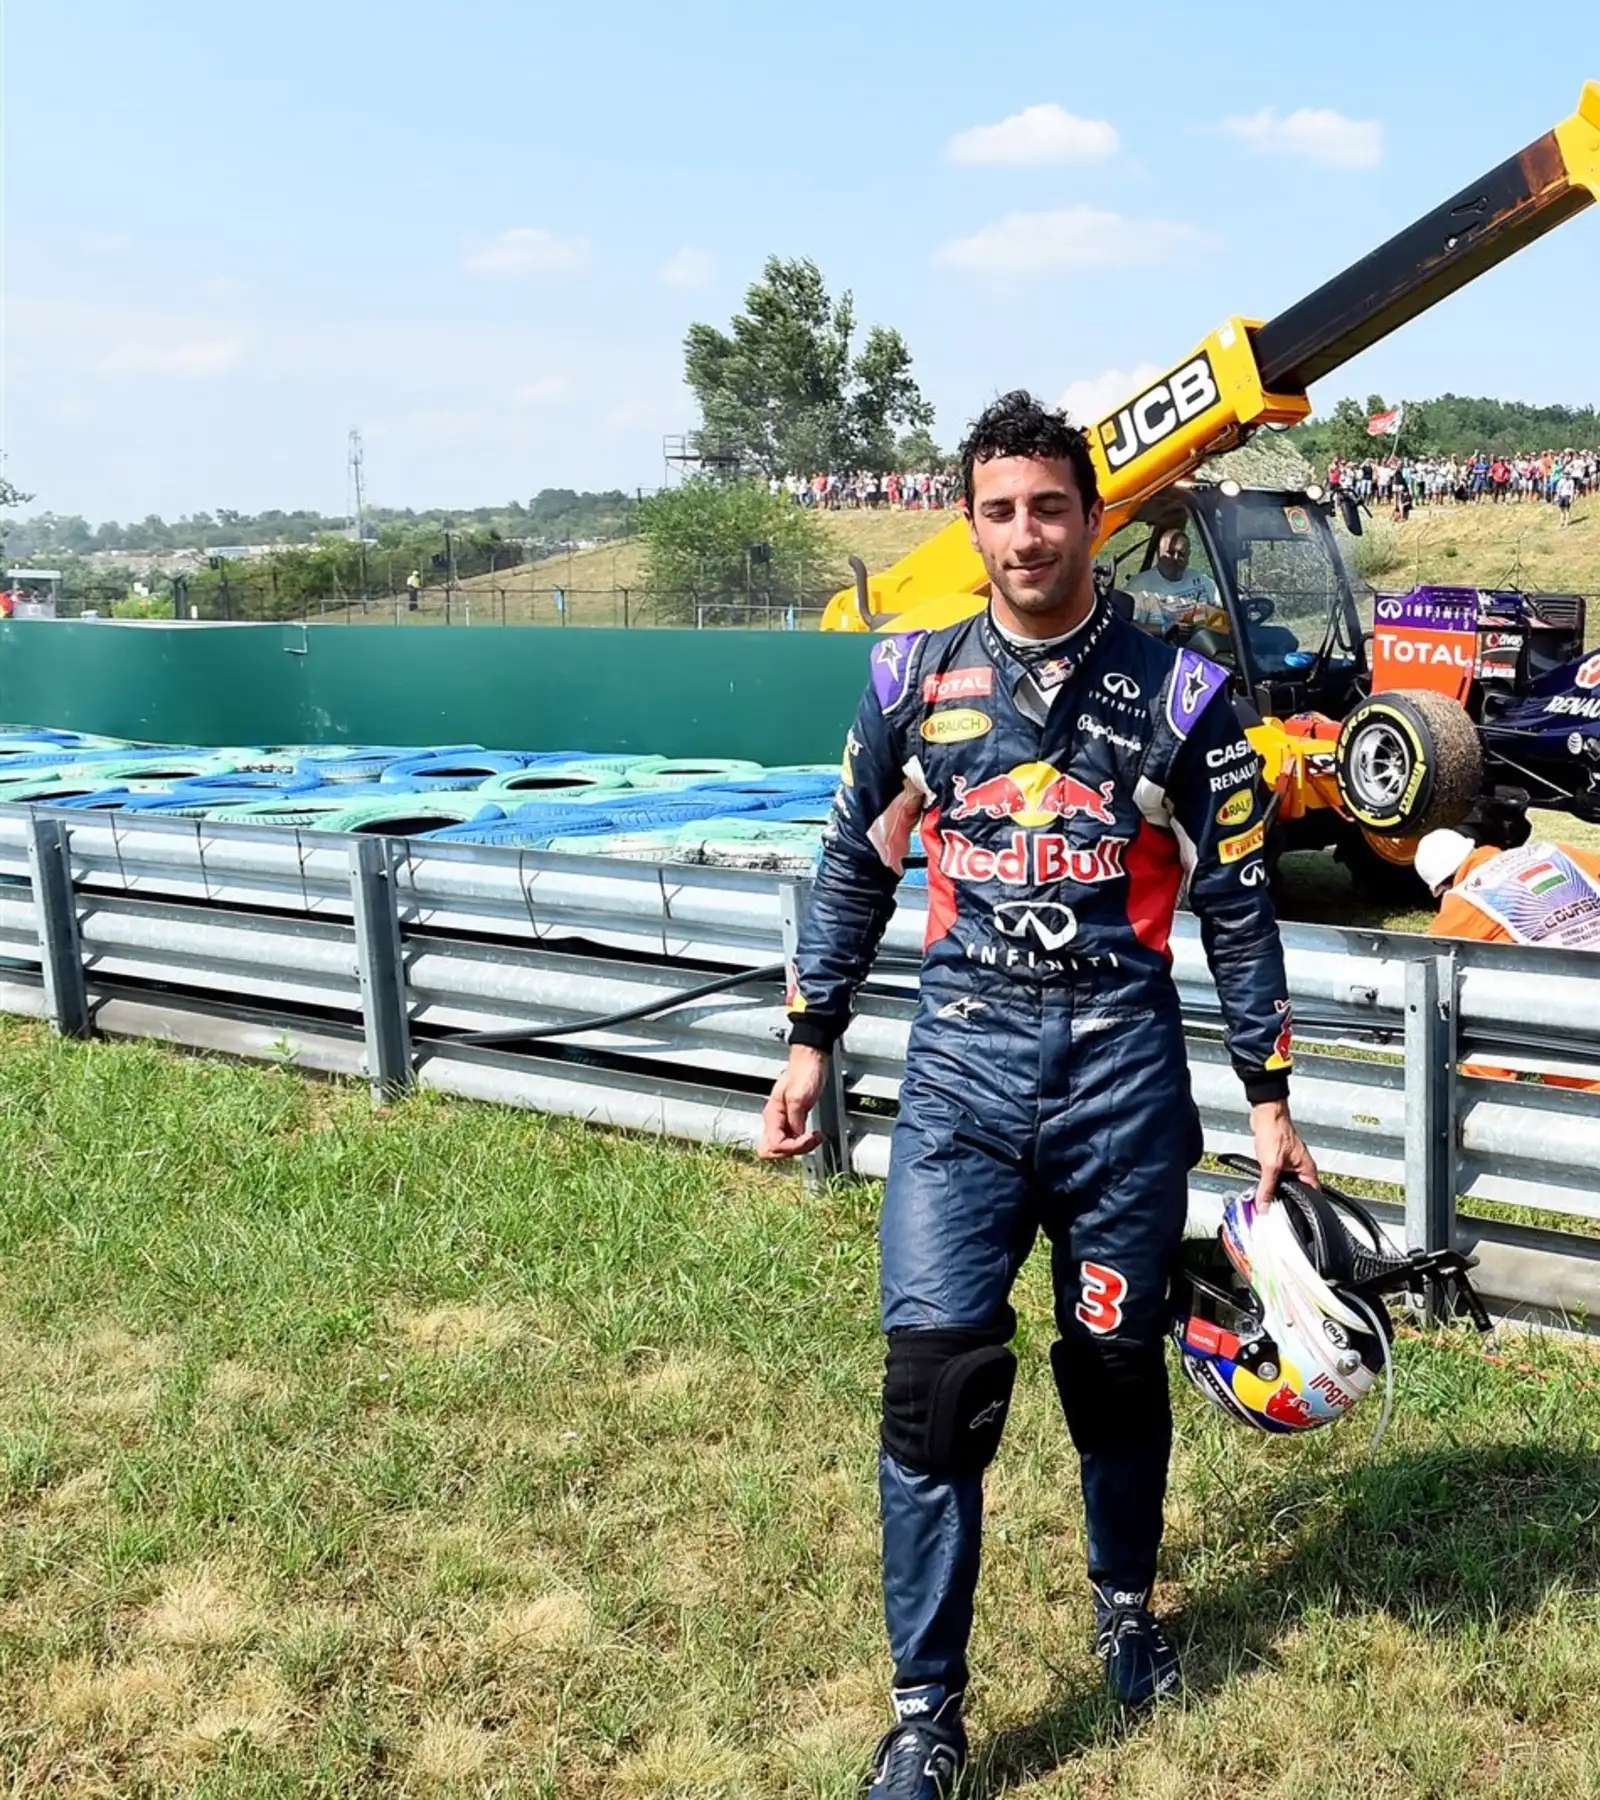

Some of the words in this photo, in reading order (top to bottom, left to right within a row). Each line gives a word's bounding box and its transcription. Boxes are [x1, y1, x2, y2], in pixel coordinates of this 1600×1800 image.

[1106, 359, 1217, 467] JCB
[1406, 603, 1478, 621] INFINITI
[1376, 633, 1473, 668] TOTAL
[926, 676, 988, 695] TOTAL
[1088, 690, 1147, 719] INFINITI
[937, 716, 981, 734] RAUCH
[941, 829, 1028, 885] Red
[1033, 833, 1130, 886] Bull
[966, 943, 1119, 971] INFINITI
[1076, 1261, 1127, 1334] 3
